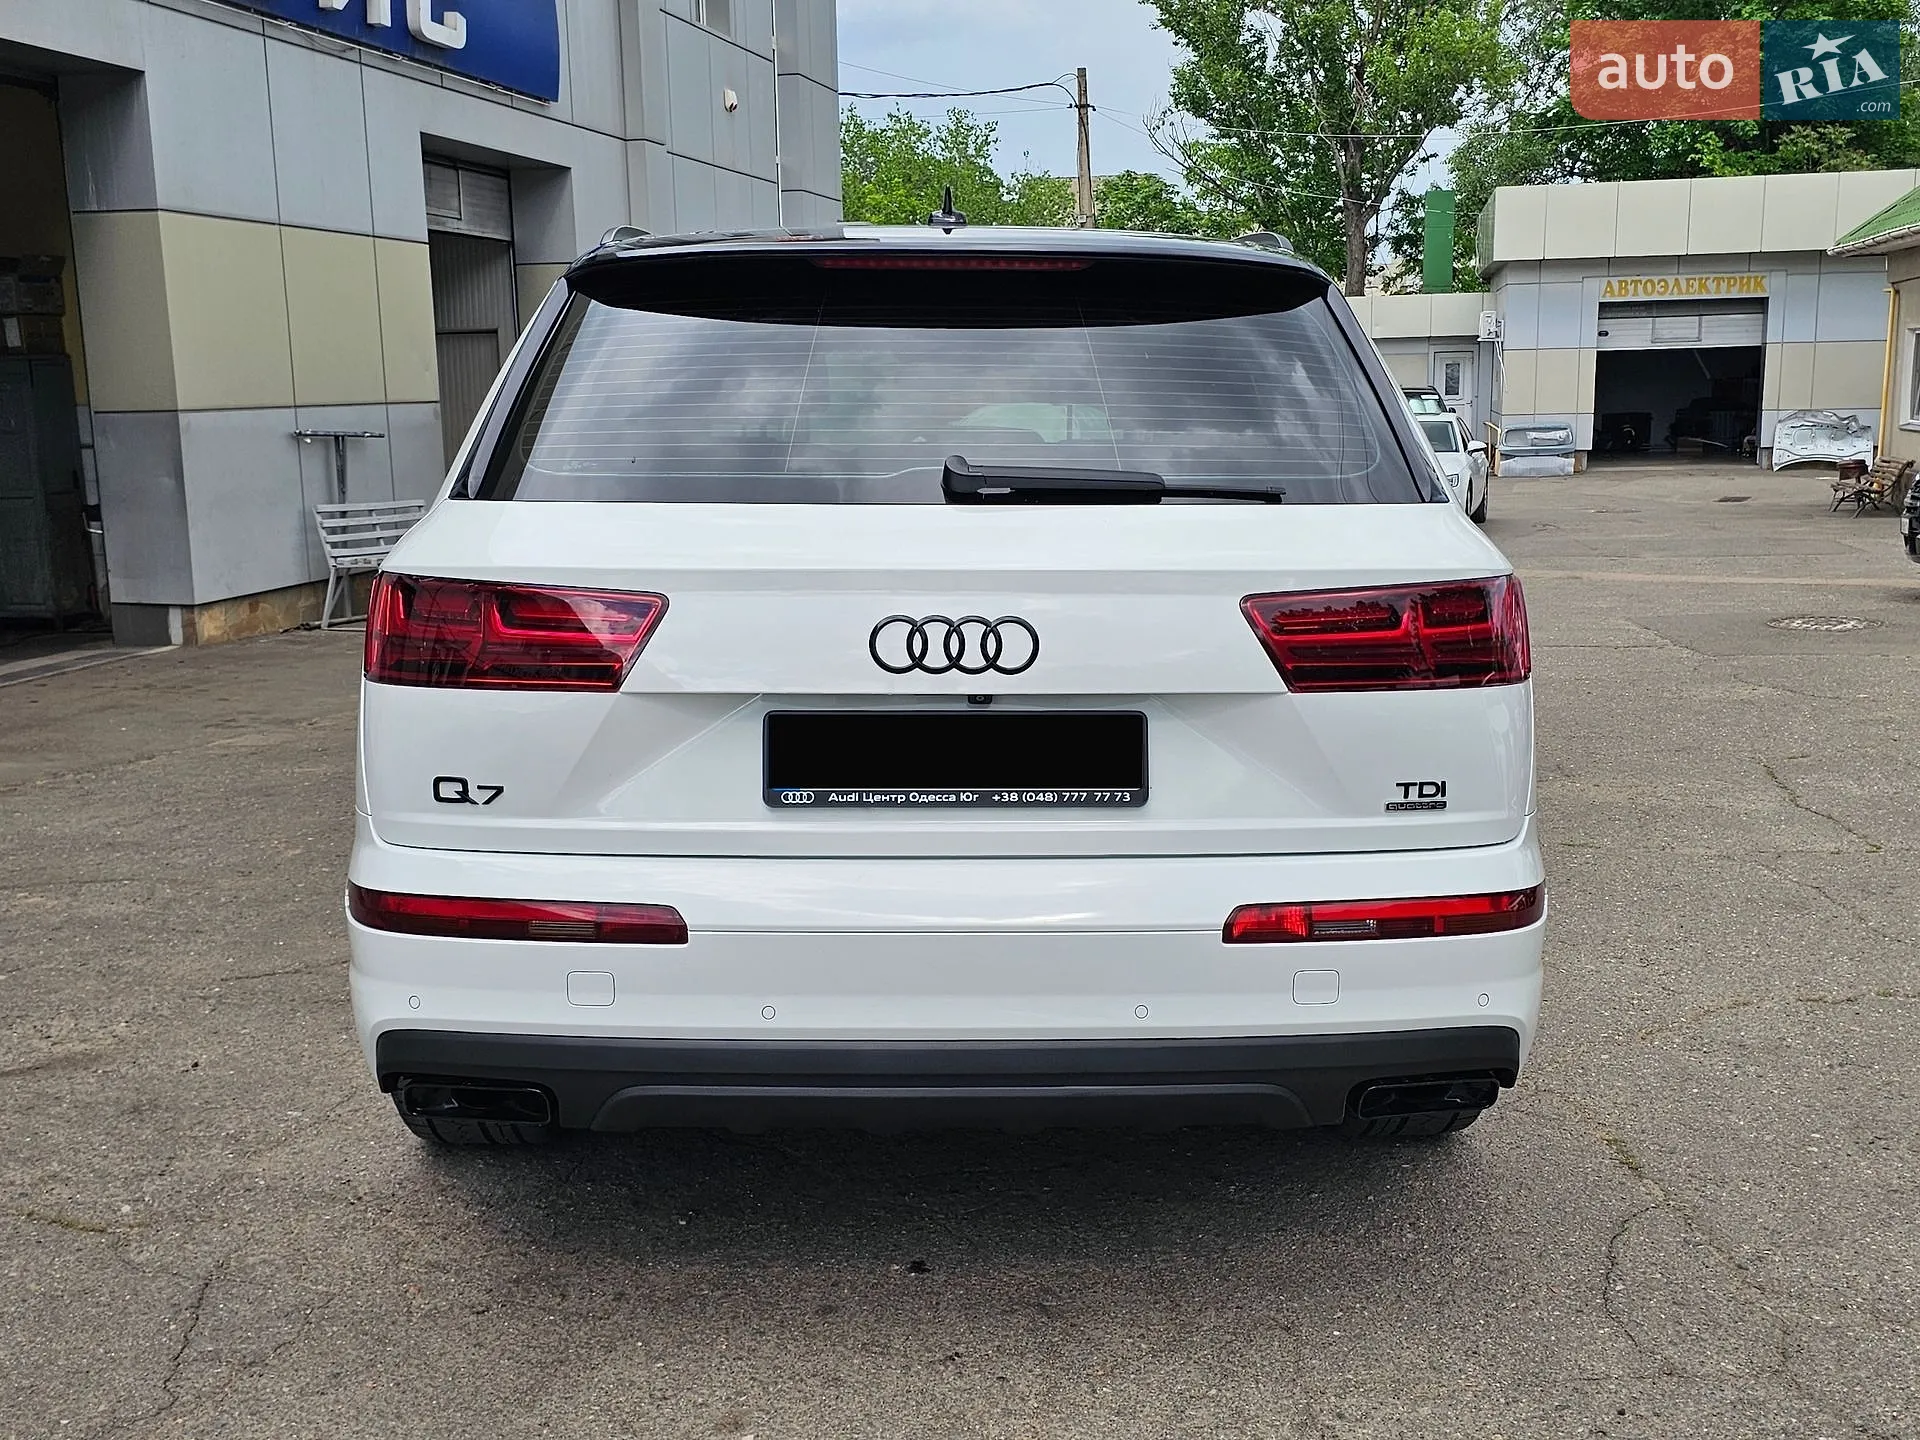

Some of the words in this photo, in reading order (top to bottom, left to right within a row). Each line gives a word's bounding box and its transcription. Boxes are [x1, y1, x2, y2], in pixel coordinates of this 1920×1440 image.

[1601, 275, 1768, 299] АВТОЭЛЕКТРИК
[433, 776, 504, 805] Q7
[828, 792, 859, 802] Audi
[863, 792, 906, 804] Центр
[909, 792, 957, 803] Одесса
[960, 792, 979, 802] Юг
[992, 792, 1019, 802] +38
[1022, 792, 1058, 803] (048)
[1062, 792, 1087, 802] 777
[1094, 792, 1111, 802] 77
[1114, 792, 1131, 802] 73
[1396, 780, 1447, 800] TDI
